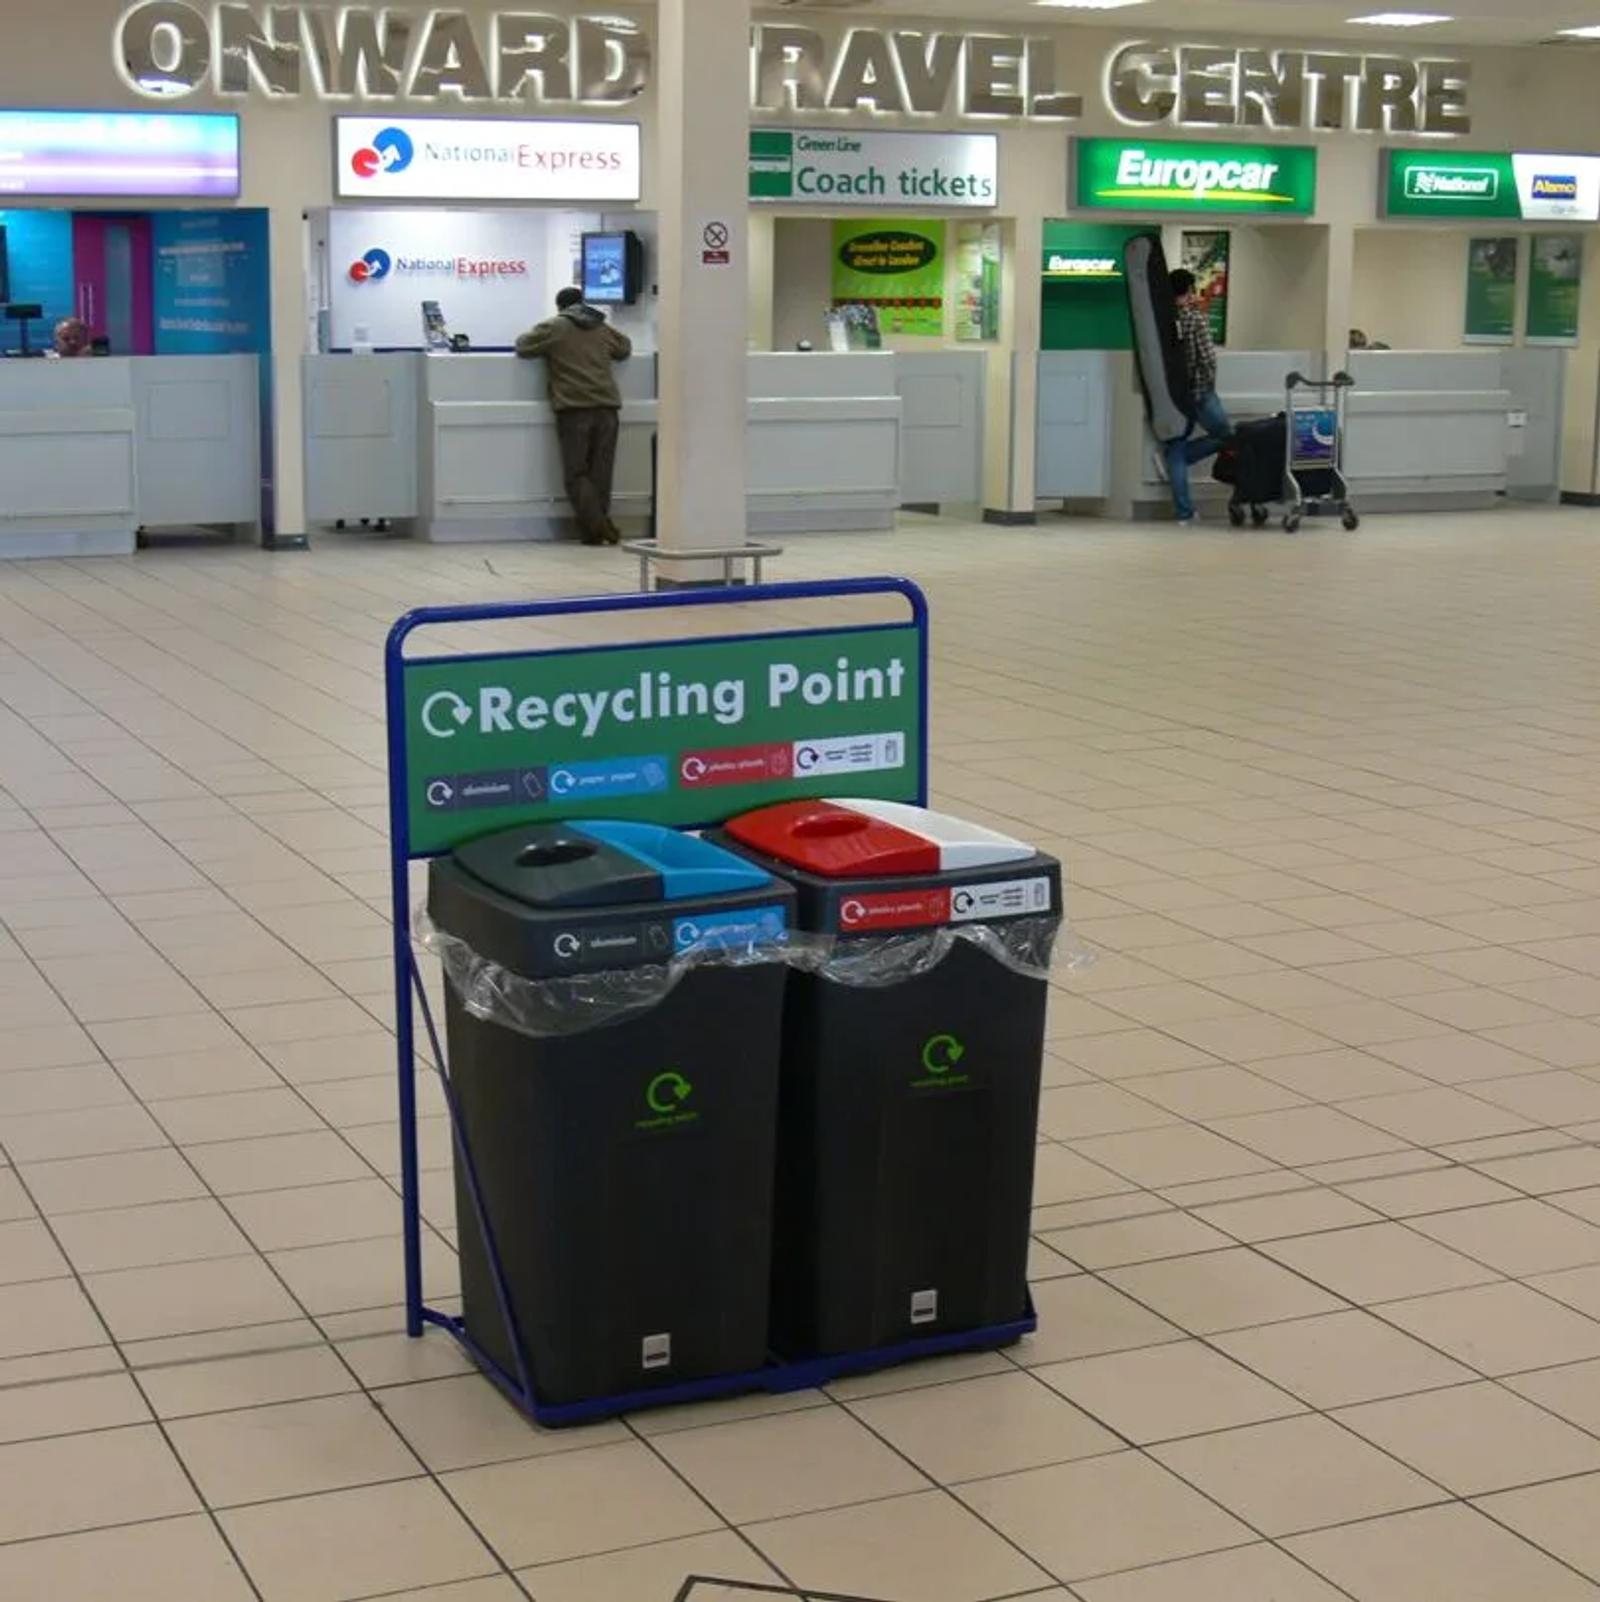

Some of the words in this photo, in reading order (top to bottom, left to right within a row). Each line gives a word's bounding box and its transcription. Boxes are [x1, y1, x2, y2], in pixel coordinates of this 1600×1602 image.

[115, 0, 651, 105] ONWARD
[750, 22, 1083, 121] RAVEL
[1102, 39, 1473, 137] CENTRE
[797, 136, 835, 151] Green
[837, 137, 862, 152] Line
[797, 166, 885, 195] Coach
[898, 168, 992, 197] tickets
[1116, 149, 1279, 198] Europcar
[1433, 173, 1490, 193] National
[1534, 180, 1577, 195] Alamo
[478, 672, 746, 738] Recycling
[768, 657, 906, 708] Point
